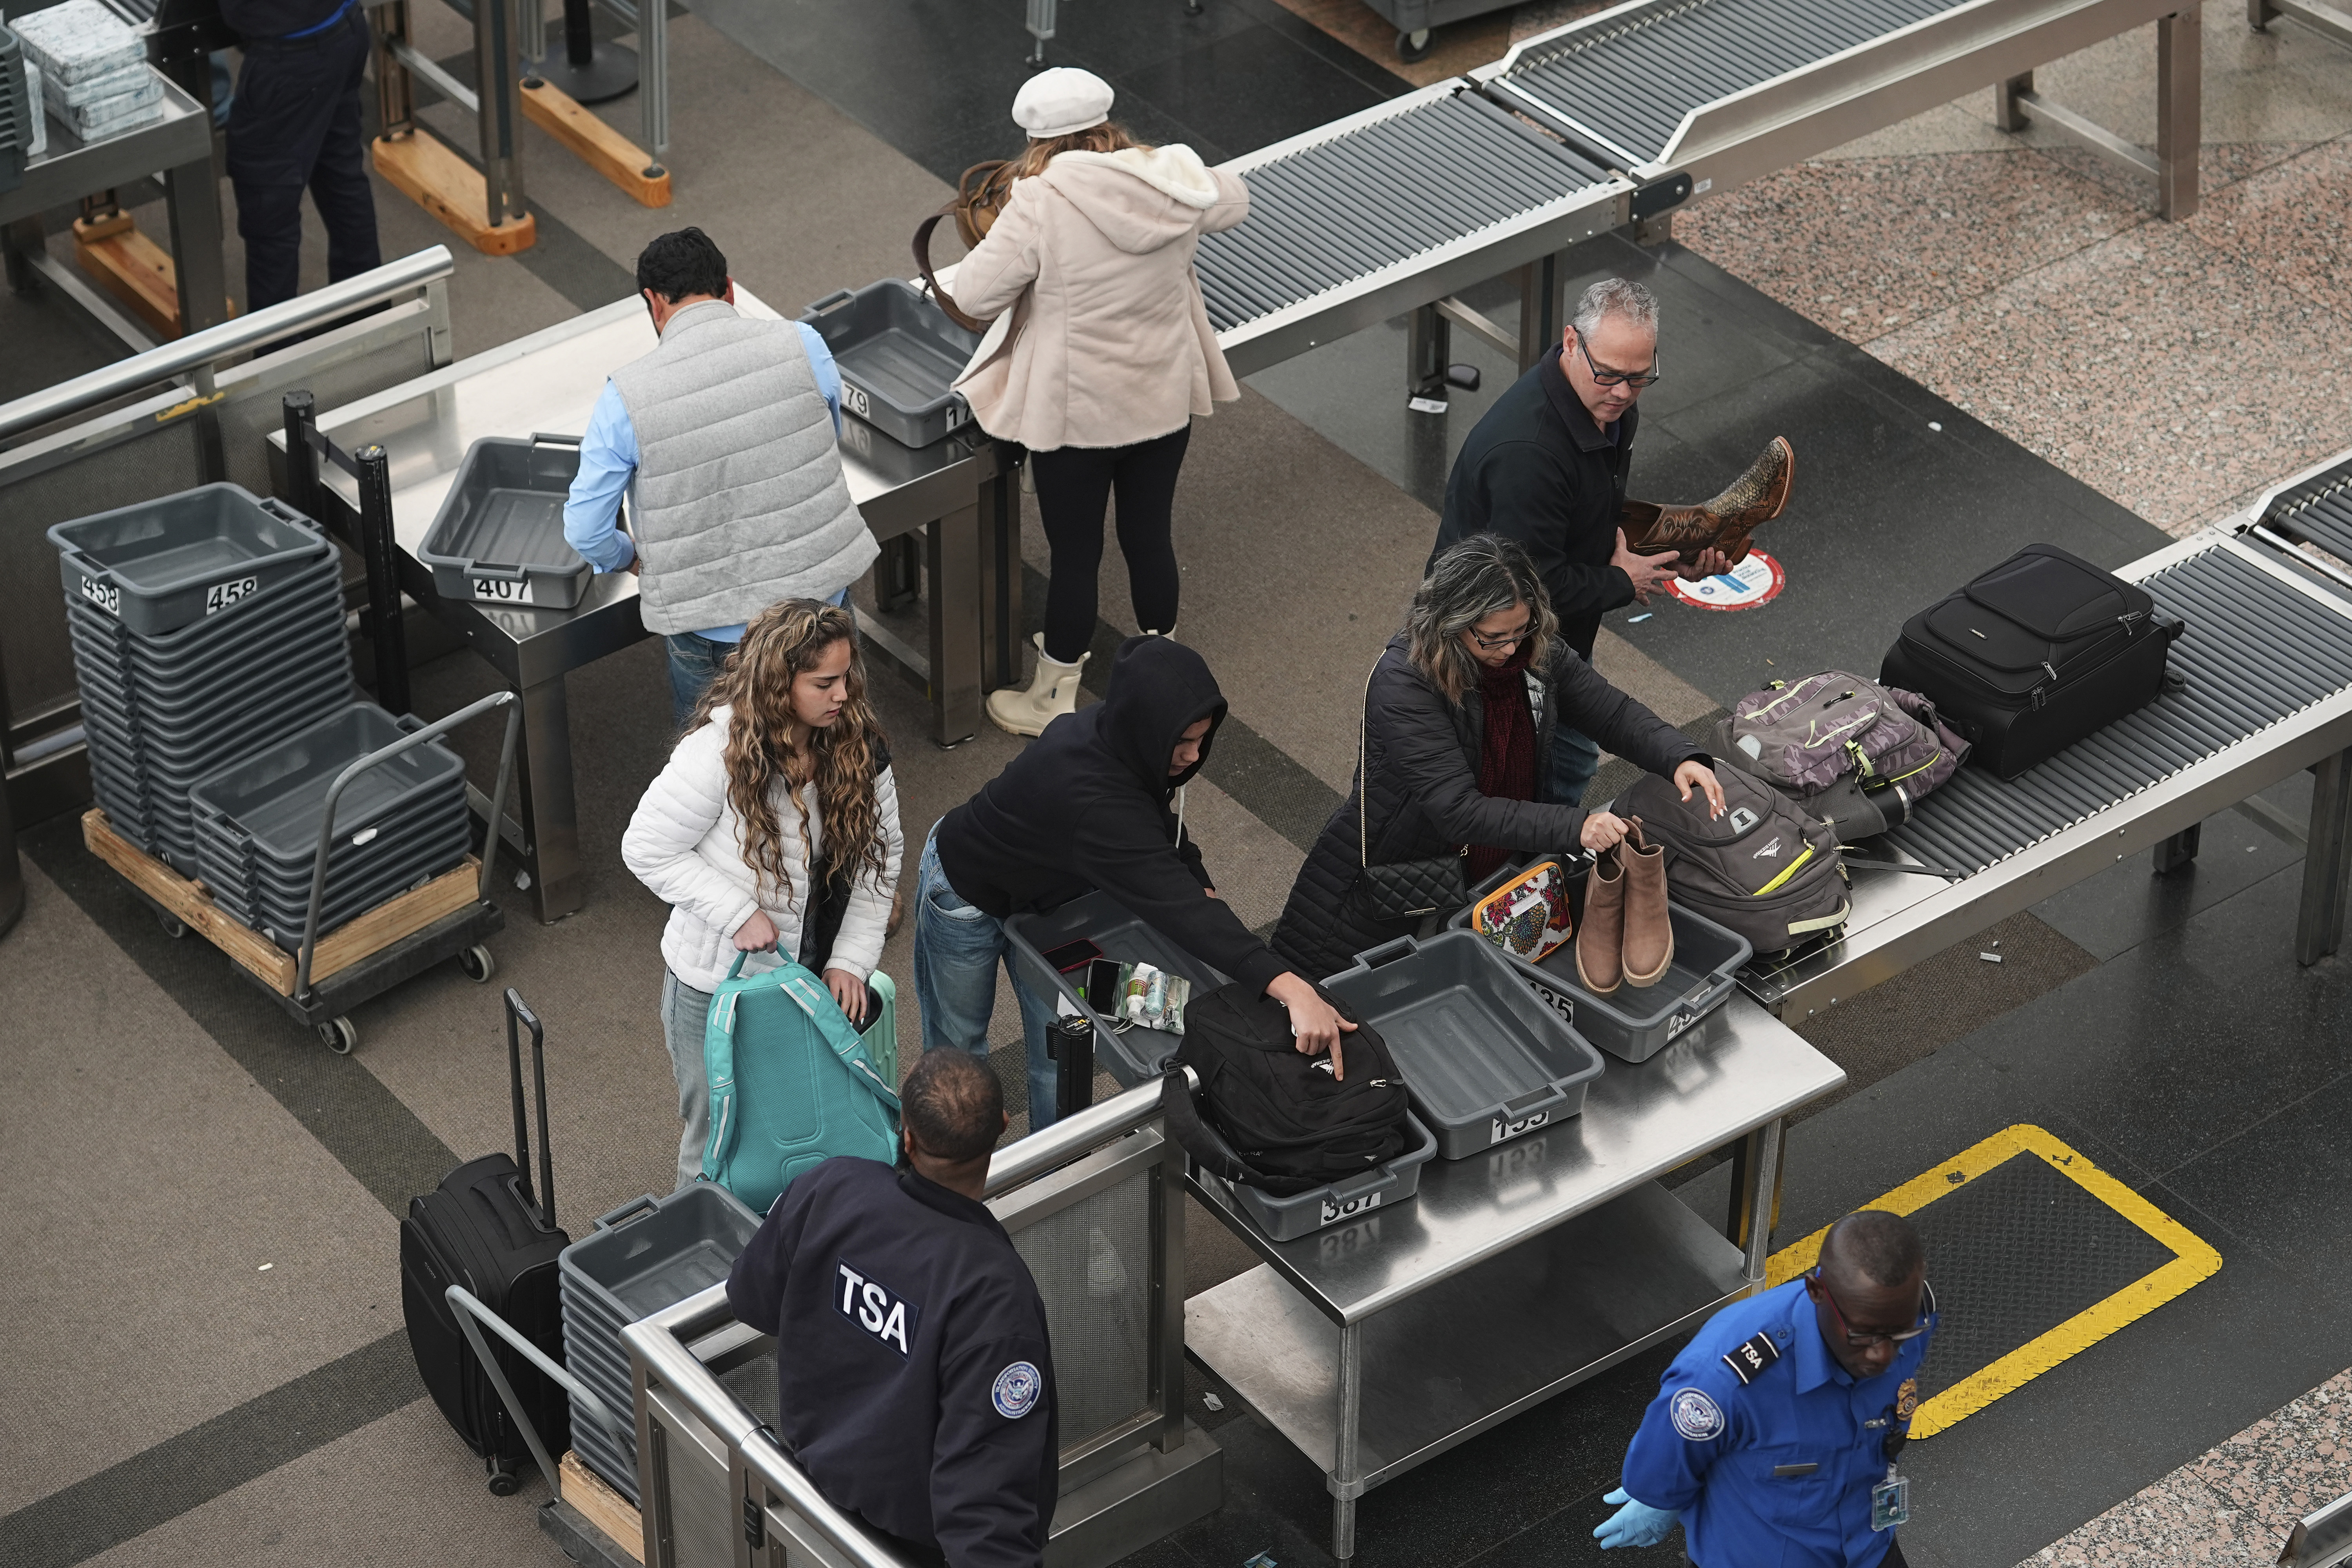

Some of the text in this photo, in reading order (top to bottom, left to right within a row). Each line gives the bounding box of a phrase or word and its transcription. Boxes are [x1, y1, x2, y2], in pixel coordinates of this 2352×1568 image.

[840, 383, 867, 414] 79
[83, 577, 117, 612] 458
[208, 579, 255, 611] 458
[477, 580, 528, 600] 407
[840, 1264, 907, 1354] TSA
[1741, 1342, 1763, 1369] TSA
[995, 1365, 1028, 1393] TRANSPORTATION
[998, 1400, 1032, 1415] ADMINISTRATION
